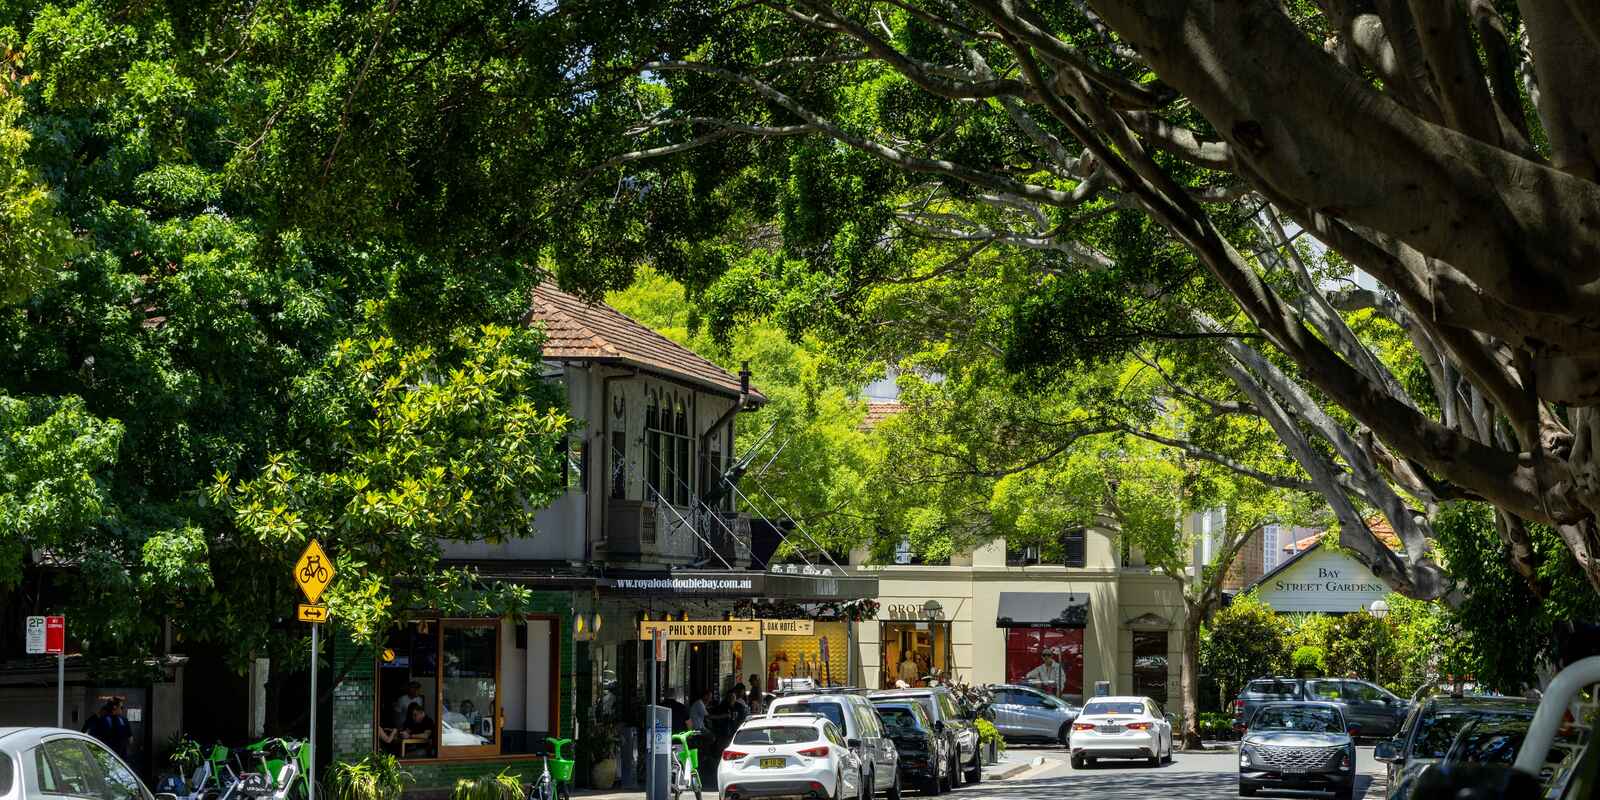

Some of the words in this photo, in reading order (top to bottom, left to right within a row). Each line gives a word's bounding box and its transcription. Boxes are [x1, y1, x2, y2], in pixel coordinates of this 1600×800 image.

[1275, 581, 1322, 592] STREET
[1325, 581, 1383, 592] GARDENS
[888, 603, 943, 614] OROT
[29, 618, 44, 628] 2P
[767, 622, 779, 631] OAK
[780, 620, 798, 632] HOTEL
[669, 622, 695, 636] PHIL'S
[697, 622, 733, 636] ROOFTOP
